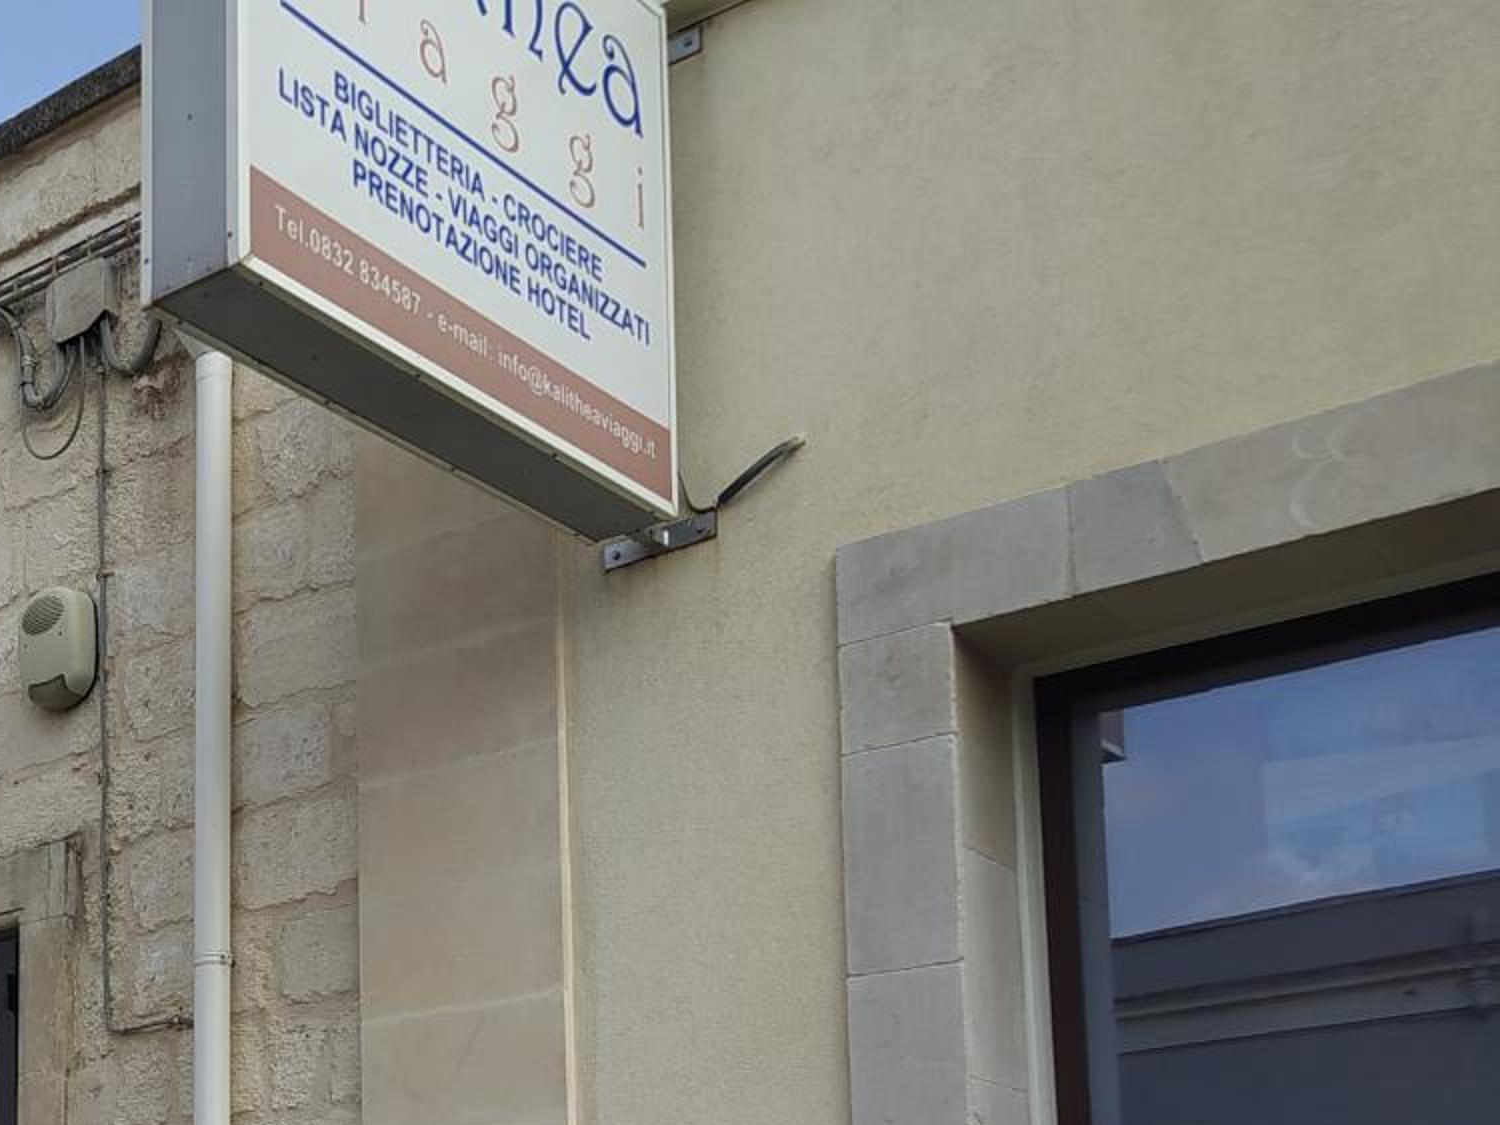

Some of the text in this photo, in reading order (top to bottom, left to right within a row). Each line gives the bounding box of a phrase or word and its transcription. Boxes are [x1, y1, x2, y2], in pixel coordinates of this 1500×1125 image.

[274, 203, 355, 276] Tel.0832
[278, 66, 347, 144] LISTA
[354, 121, 429, 199] NOZZE
[447, 186, 519, 259] VIAGGI
[524, 242, 650, 346] ORGANIZZATI
[334, 70, 486, 203] BIGLIETTERIA
[503, 193, 603, 283] CROCIERE
[352, 157, 591, 341] PRENOTAZIONE HOTEL
